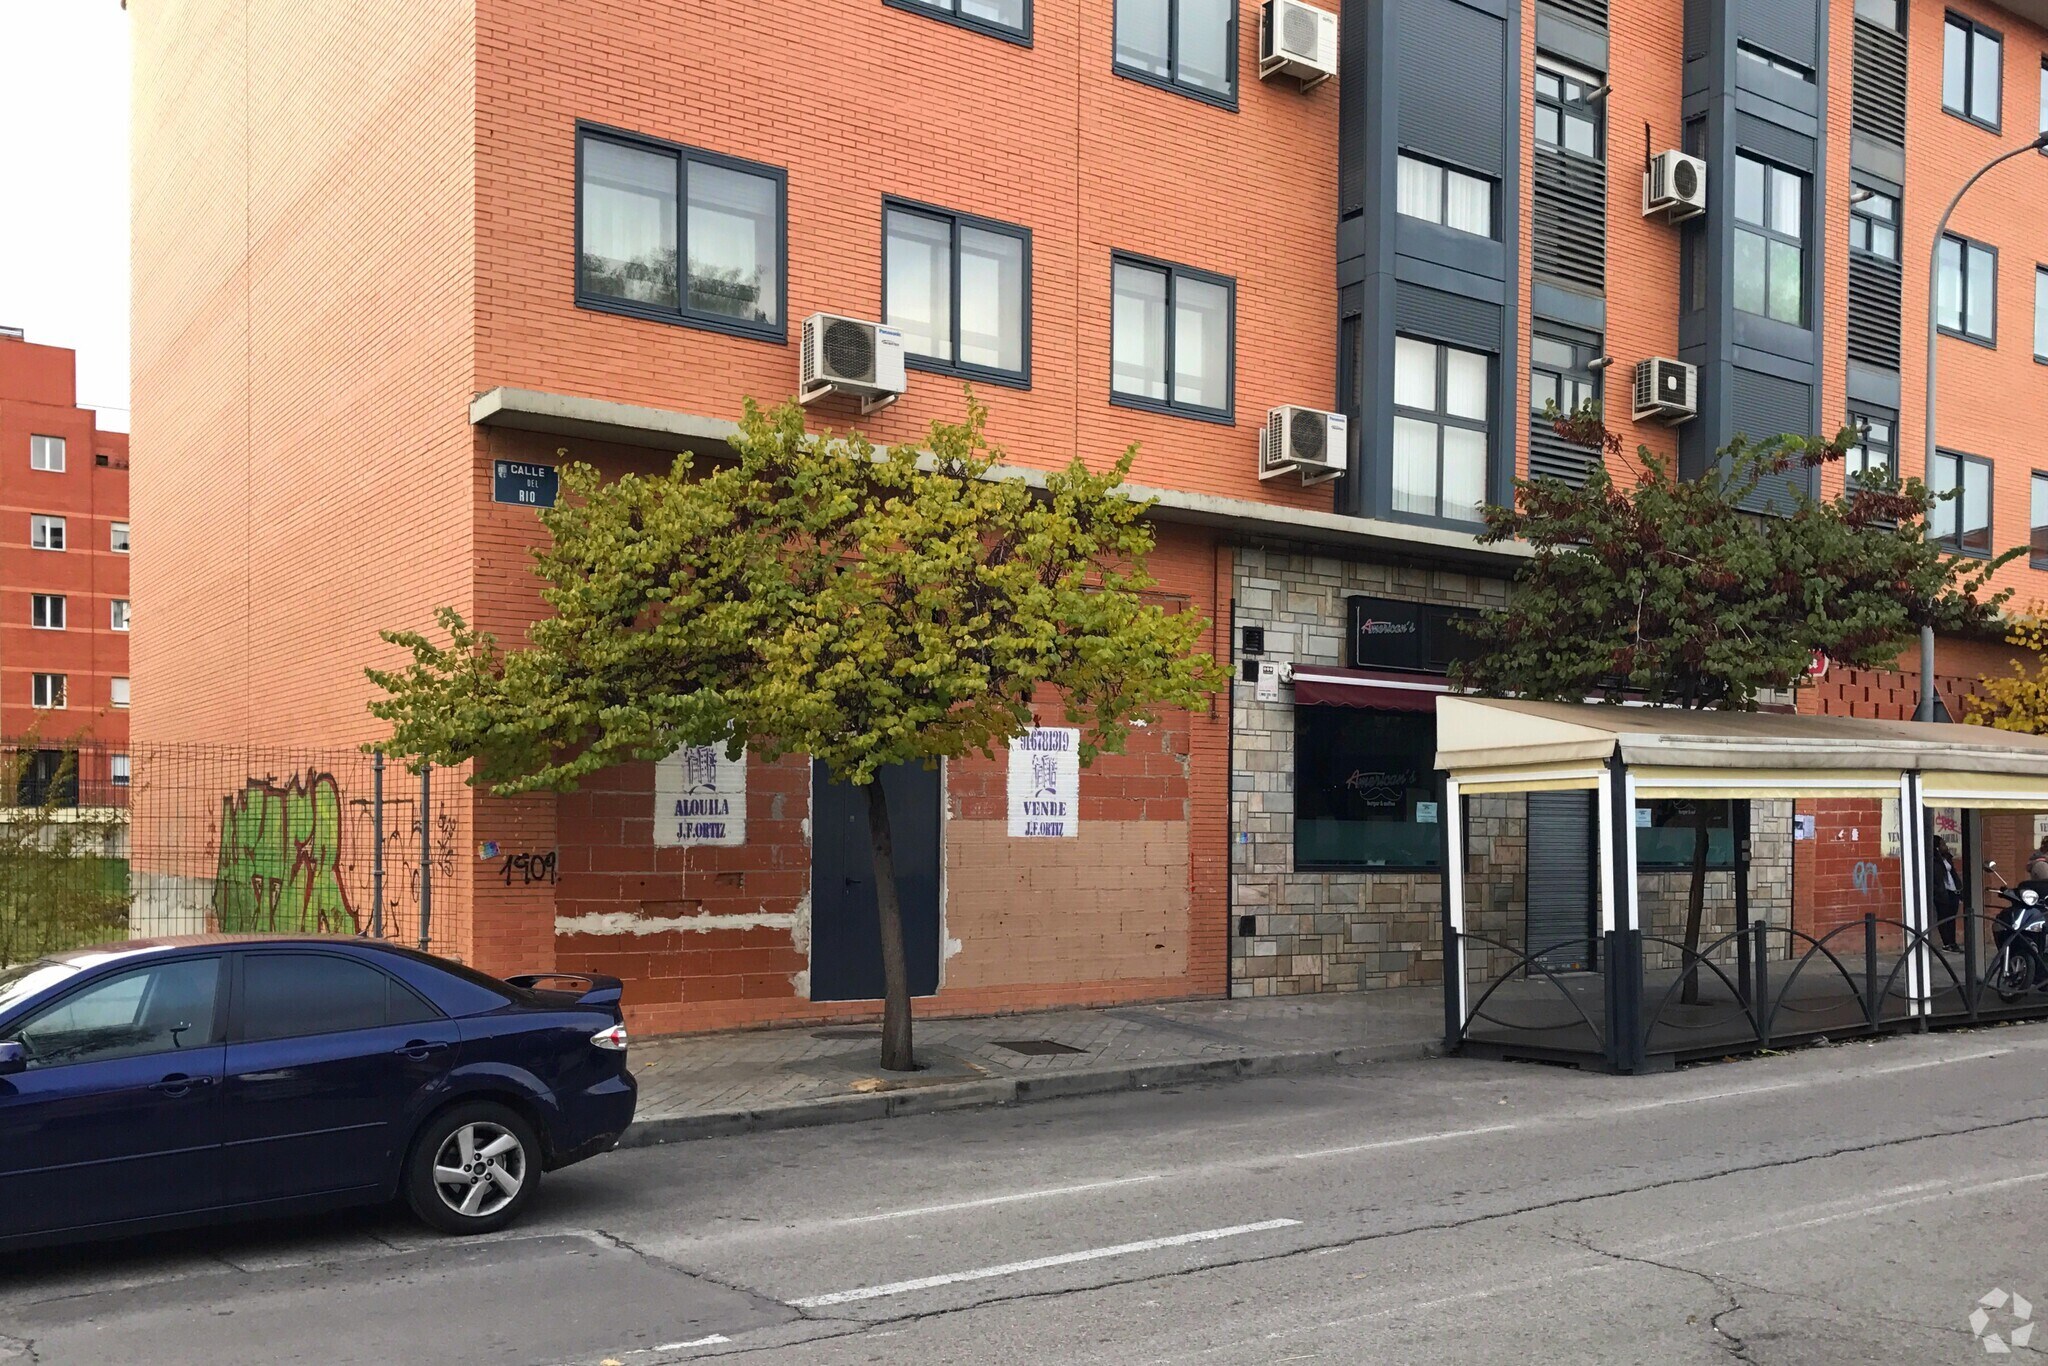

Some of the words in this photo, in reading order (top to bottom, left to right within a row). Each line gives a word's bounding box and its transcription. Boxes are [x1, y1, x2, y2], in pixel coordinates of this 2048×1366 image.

[510, 464, 545, 477] CALLE
[526, 479, 539, 488] DEL
[519, 489, 536, 503] RIO
[1361, 618, 1416, 635] American's
[674, 799, 729, 817] ALQUILA
[1023, 801, 1067, 816] VENDE
